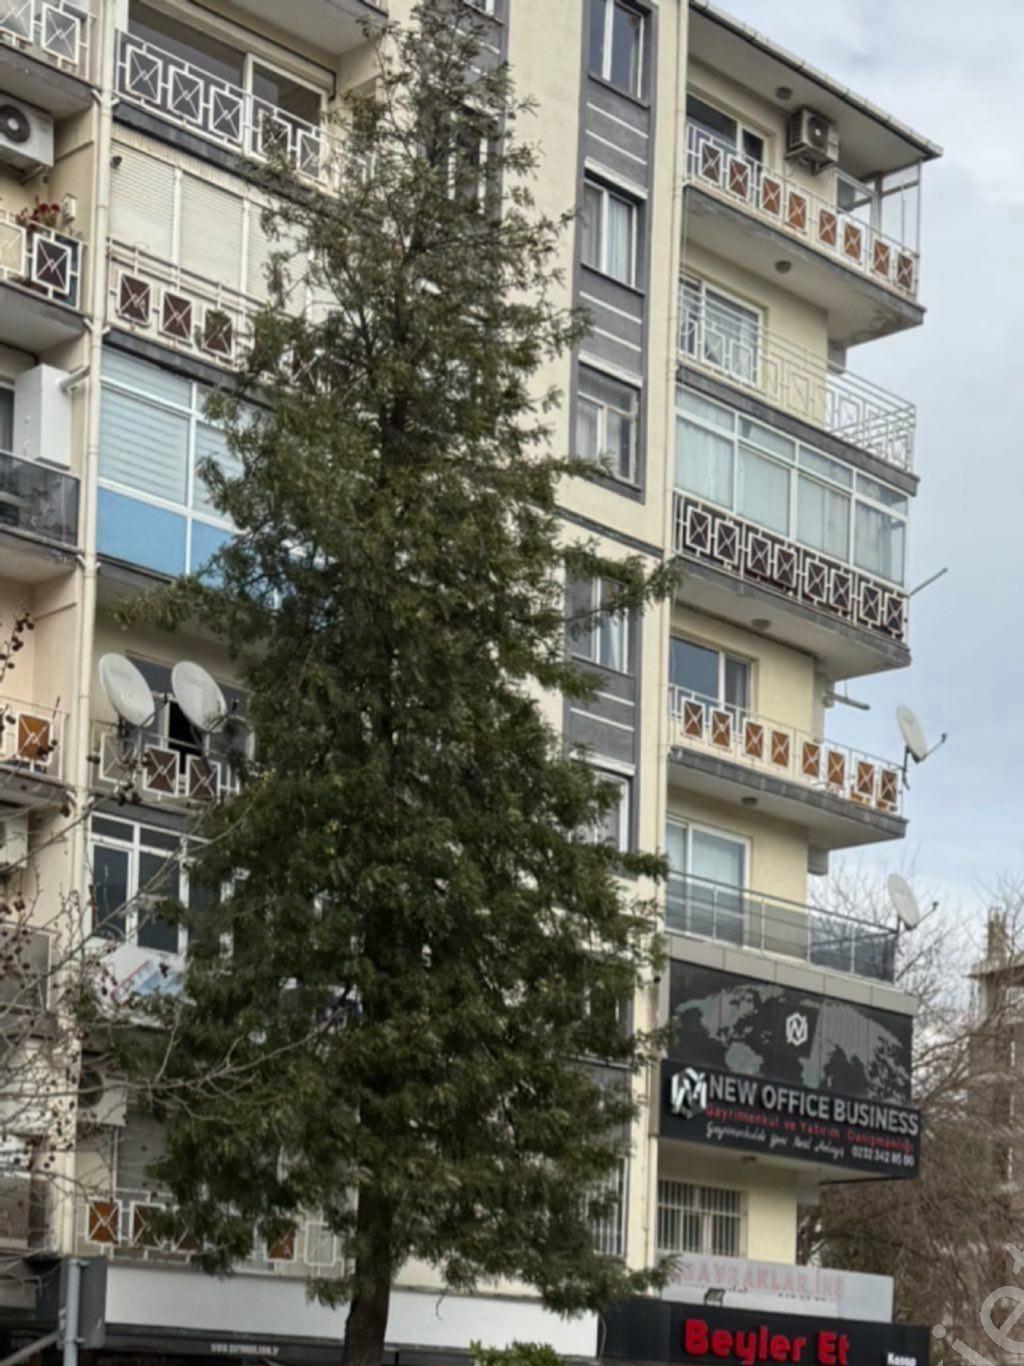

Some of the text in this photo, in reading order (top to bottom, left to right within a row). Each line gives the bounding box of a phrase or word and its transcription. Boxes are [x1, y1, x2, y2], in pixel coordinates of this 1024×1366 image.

[709, 1073, 920, 1136] NEW OFFICE BUSINESS
[783, 1121, 797, 1132] ve
[684, 1318, 850, 1366] Beyler Et
